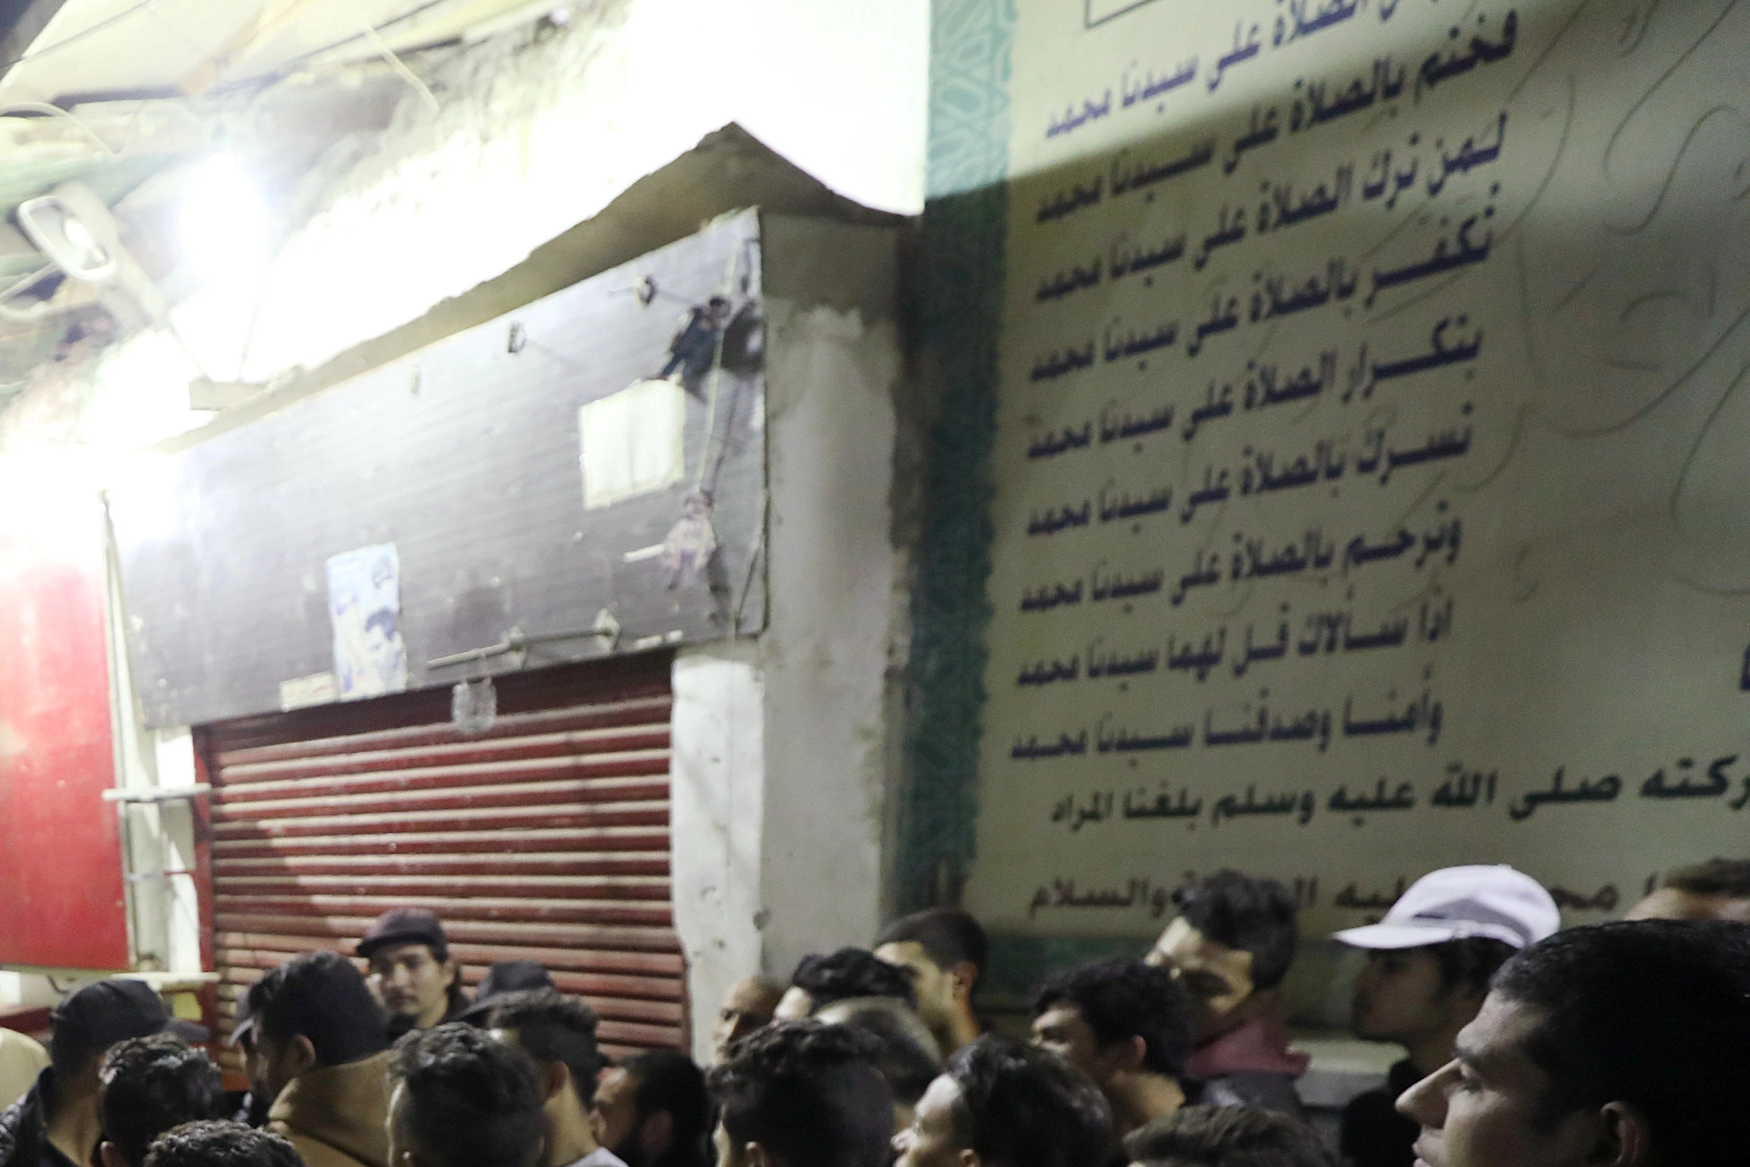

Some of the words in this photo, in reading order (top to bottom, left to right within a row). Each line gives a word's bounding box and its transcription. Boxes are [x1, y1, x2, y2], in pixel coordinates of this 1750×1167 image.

[1207, 17, 1260, 93] على
[1120, 55, 1200, 114] سيدنا
[1290, 57, 1407, 134] بالصلاة
[1045, 89, 1113, 139] محمد
[1223, 105, 1279, 177] على
[1036, 175, 1103, 223] محمد
[1109, 136, 1217, 204] سيدنا
[1256, 162, 1354, 235] الصلاة
[1362, 131, 1421, 210] ترك
[1109, 231, 1187, 287] سيدنا
[1192, 204, 1247, 272] على
[1036, 256, 1102, 301] محمد
[1250, 255, 1359, 323] بالصلاة
[1104, 316, 1180, 371] سيدنا
[1186, 293, 1240, 358] على
[1030, 338, 1095, 381] محمد
[1242, 349, 1338, 411] الصلاة
[1026, 419, 1092, 461] محمد
[1098, 398, 1174, 455] سيدنا
[1180, 380, 1234, 443] على
[1178, 464, 1231, 527] على
[1240, 439, 1346, 498] بالصلاة
[1026, 499, 1091, 538] محمد
[1098, 476, 1172, 535] سيدنا
[1091, 557, 1163, 614] سيدنا
[1169, 549, 1222, 607] على
[1230, 527, 1335, 587] بالصلاة
[1020, 578, 1084, 613] محمد
[1016, 654, 1080, 688] محمد
[1086, 635, 1160, 693] سيدنا
[1010, 728, 1088, 760] محمد
[1096, 711, 1194, 770] سيدنا
[1122, 779, 1203, 832] بلغنا
[1210, 784, 1314, 828] وسلم
[1326, 776, 1415, 828] عليه
[1428, 760, 1498, 808] الله
[1507, 764, 1623, 822] صلى
